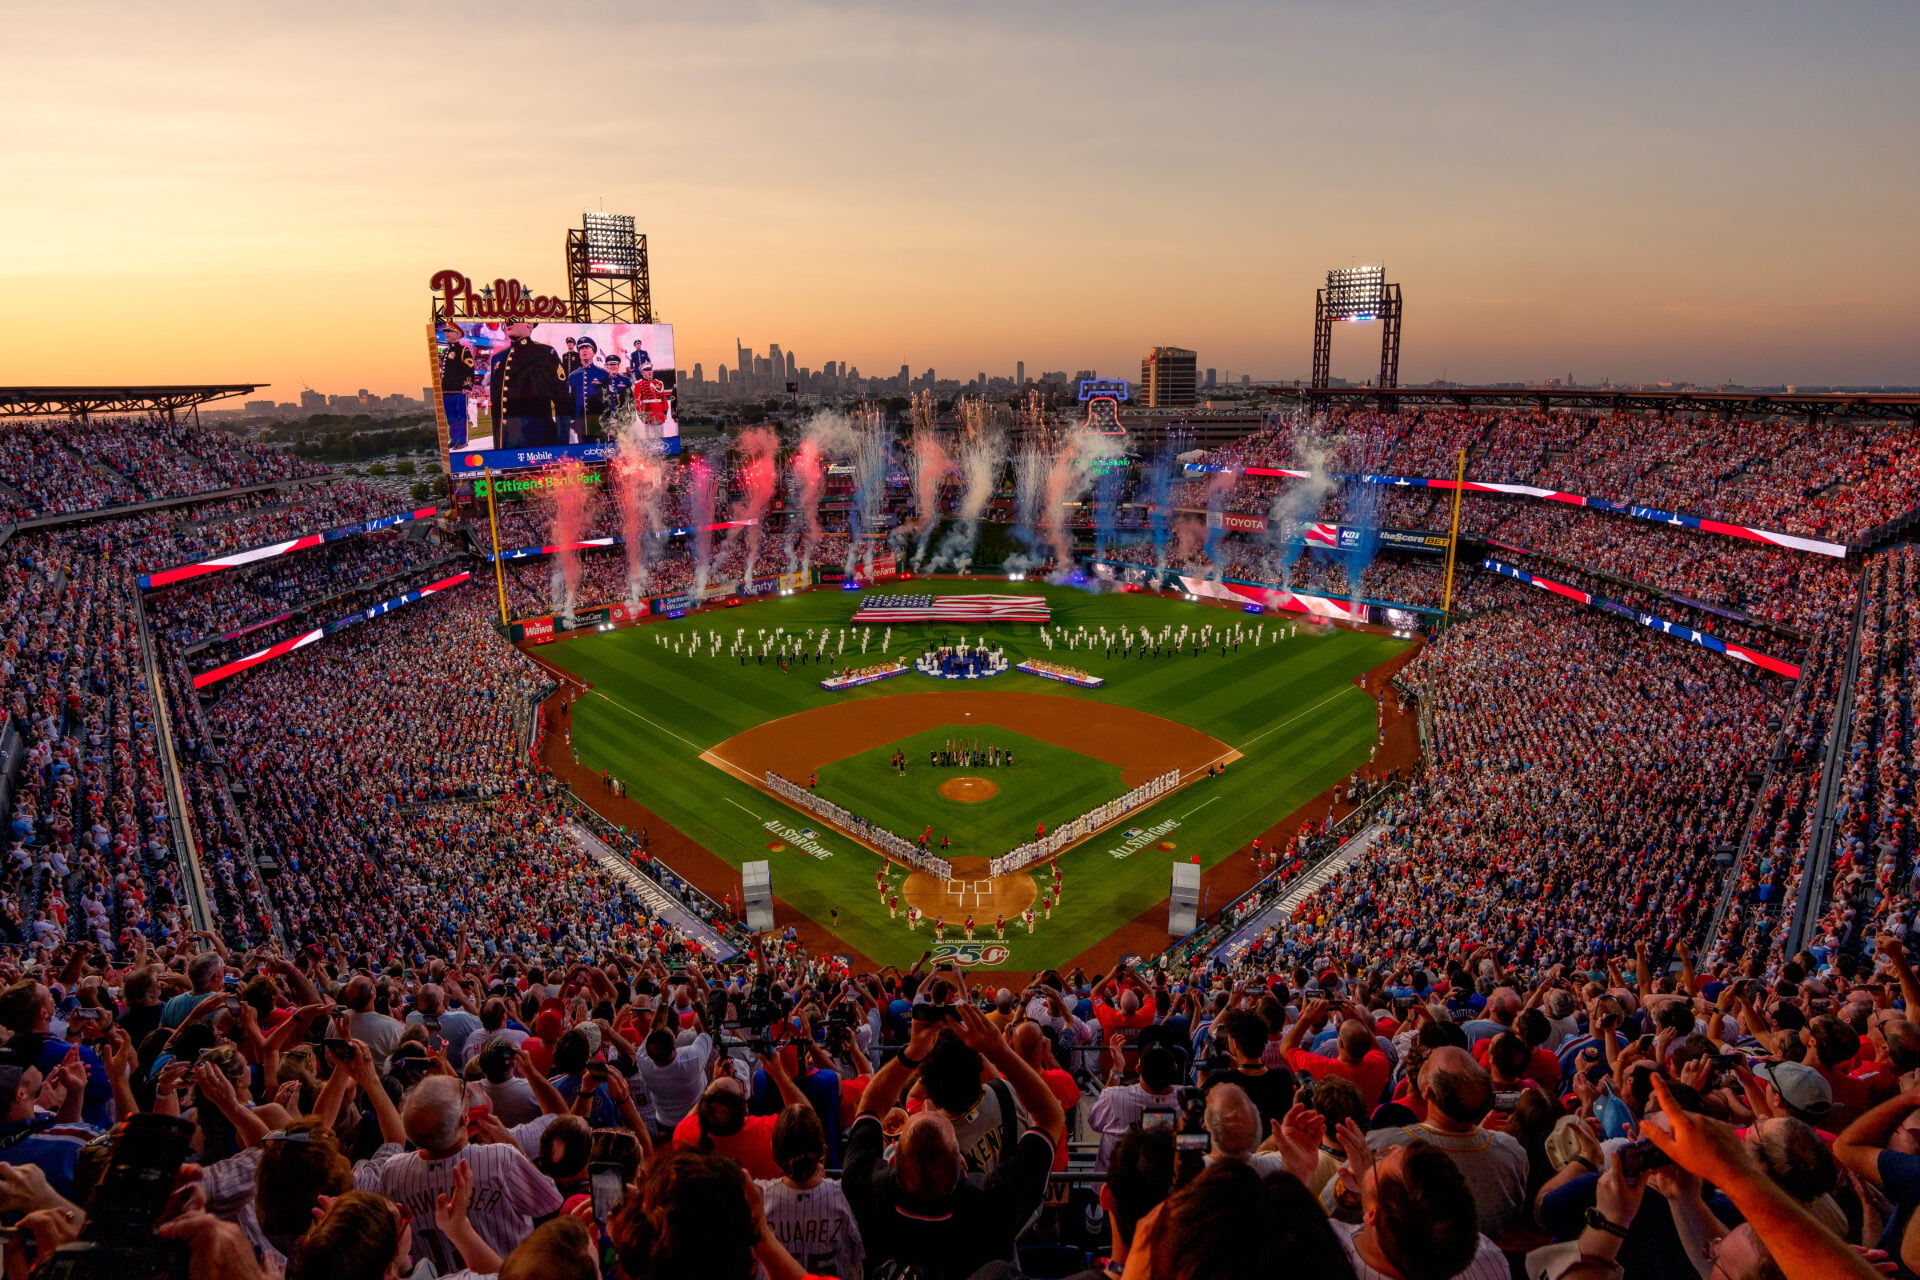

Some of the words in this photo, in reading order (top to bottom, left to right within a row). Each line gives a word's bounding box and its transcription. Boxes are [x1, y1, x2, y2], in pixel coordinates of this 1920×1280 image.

[430, 270, 567, 318] Phillies
[527, 451, 552, 461] Mobile
[584, 448, 615, 457] abbvie
[495, 479, 543, 493] Citizens
[576, 472, 602, 484] Park
[1225, 517, 1264, 529] TOYOTA
[1379, 531, 1425, 543] theScore
[1427, 538, 1449, 546] BET
[743, 580, 773, 594] xinity
[525, 624, 553, 636] Wawa
[762, 820, 786, 834] ALL
[778, 828, 808, 846] STAR
[800, 841, 834, 860] GAME
[1108, 845, 1137, 859] ALL
[1126, 832, 1159, 848] STAR
[1148, 819, 1182, 836] GAME
